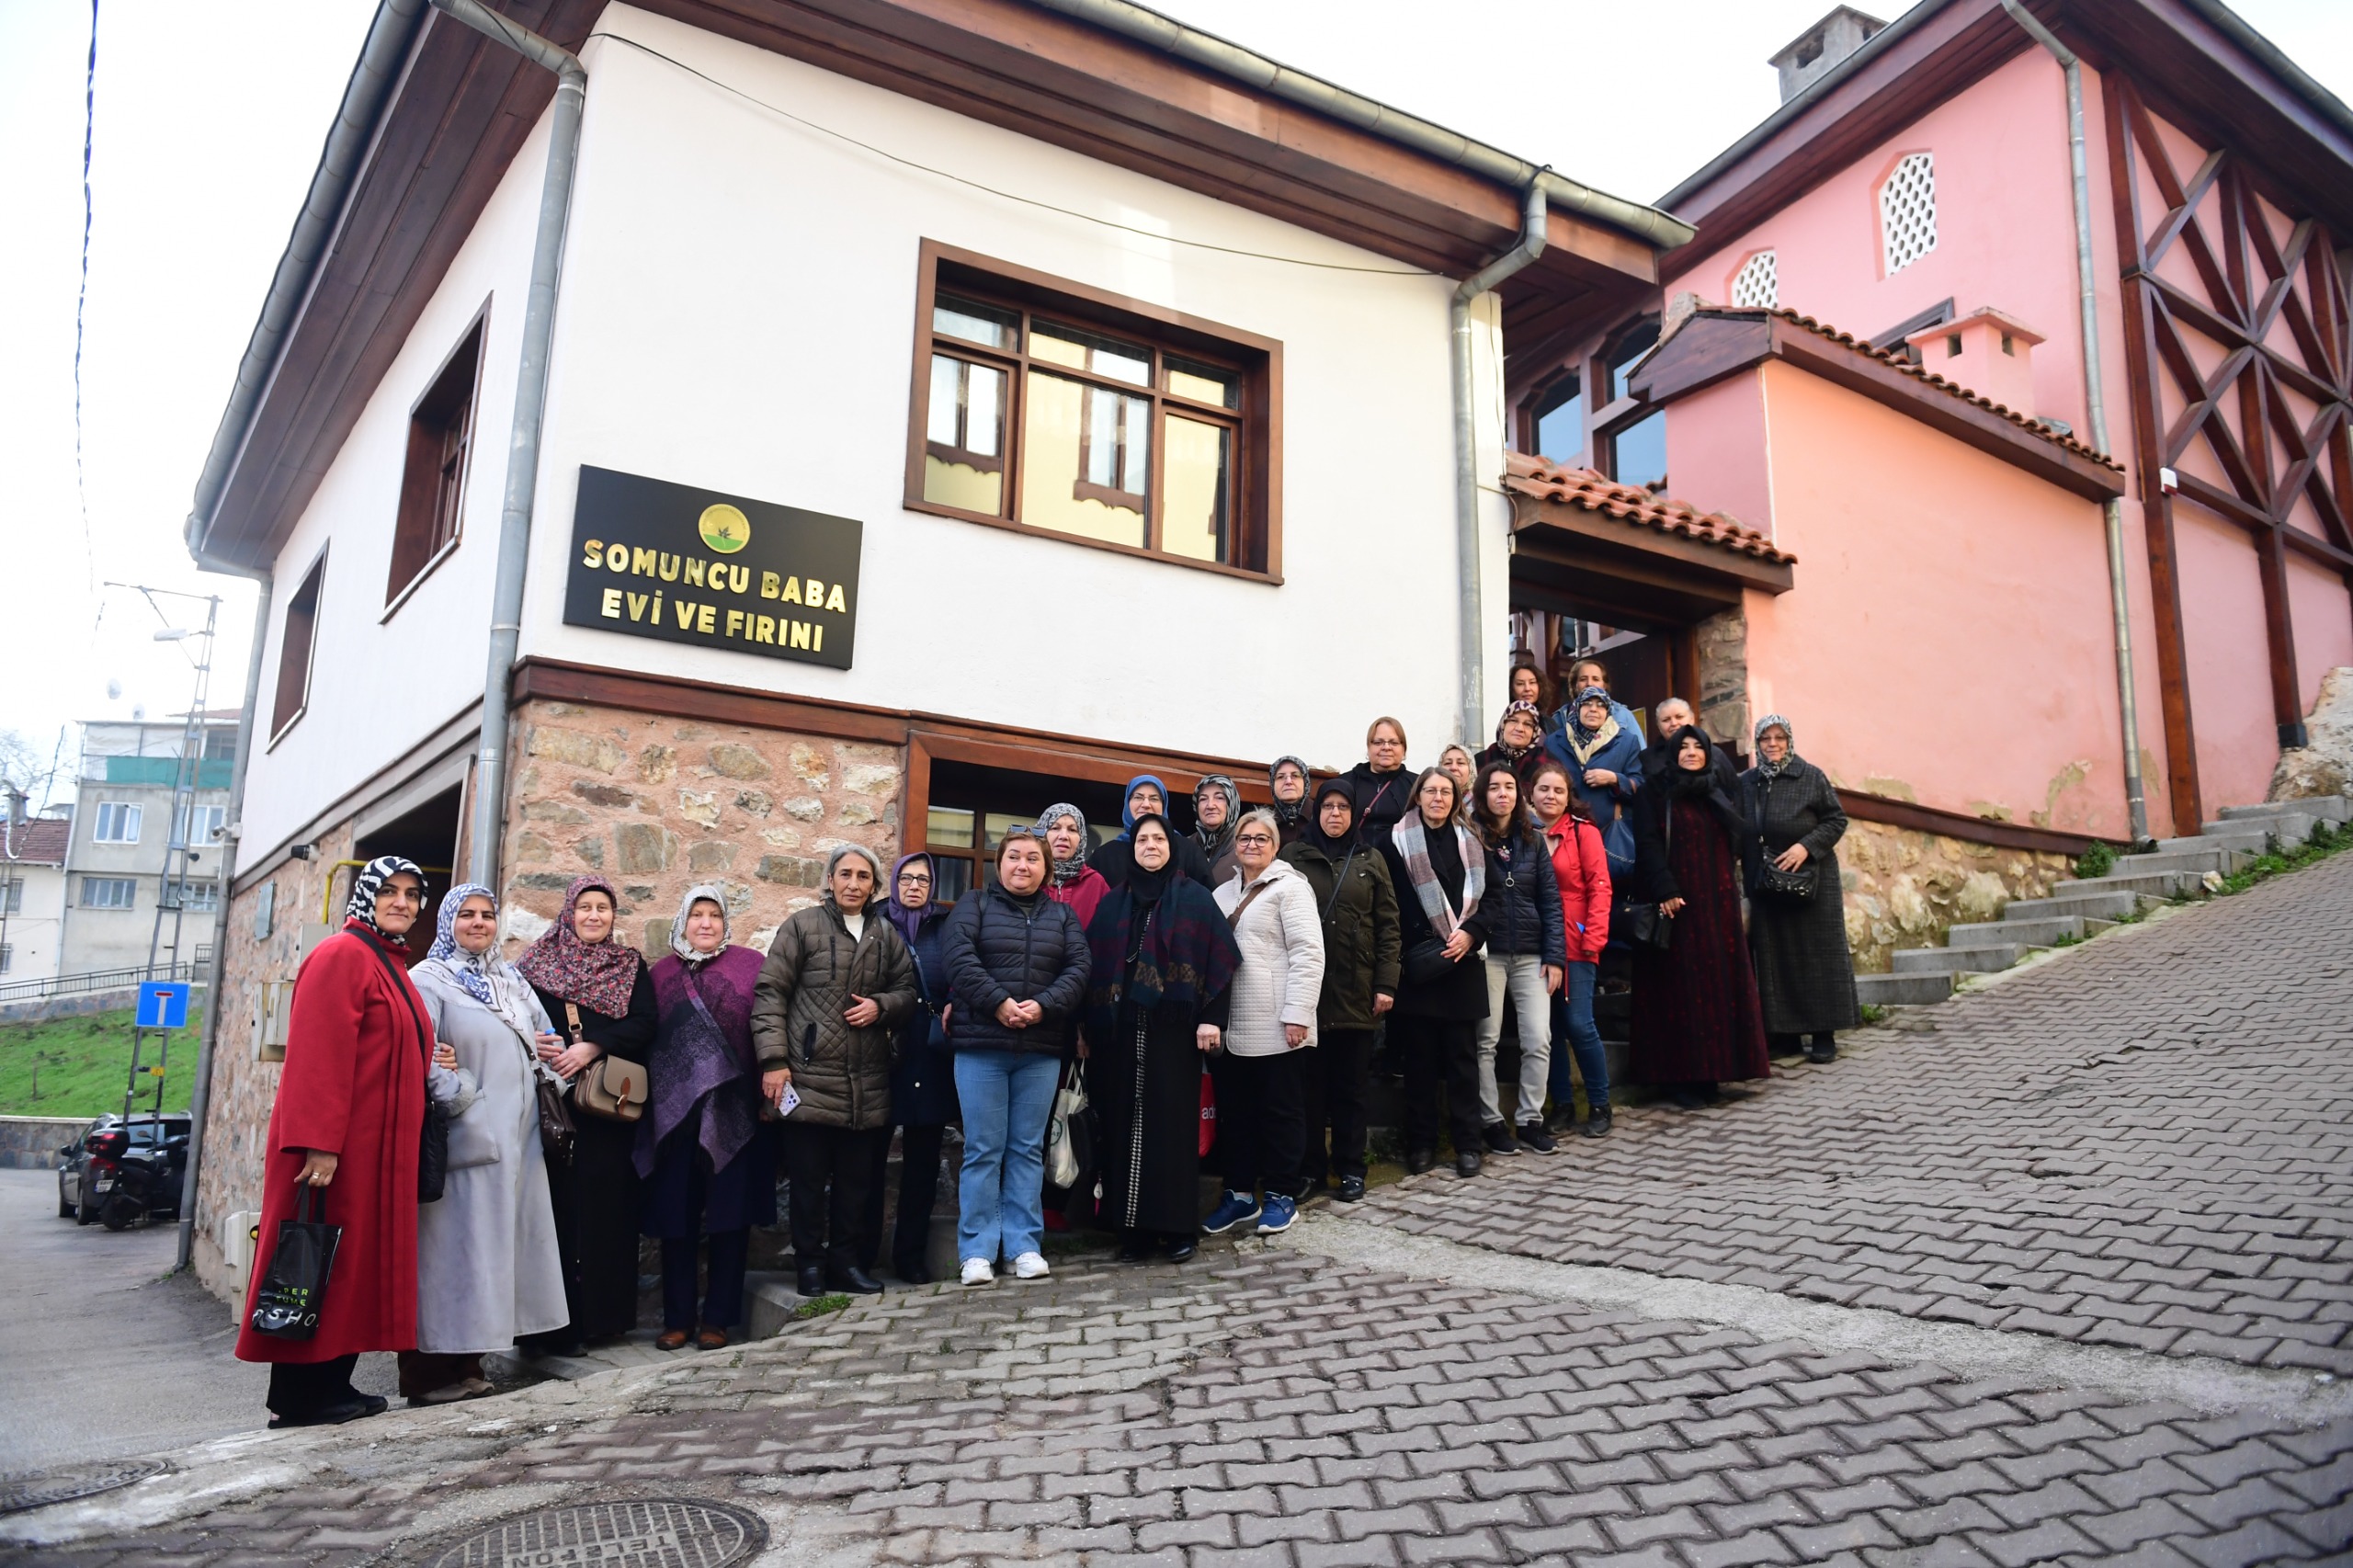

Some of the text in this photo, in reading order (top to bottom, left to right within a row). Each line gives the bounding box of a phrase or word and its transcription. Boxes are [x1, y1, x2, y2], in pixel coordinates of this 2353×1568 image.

[583, 539, 847, 613] SOMUNCU BABA
[601, 587, 824, 653] EVİ VE FIRINI
